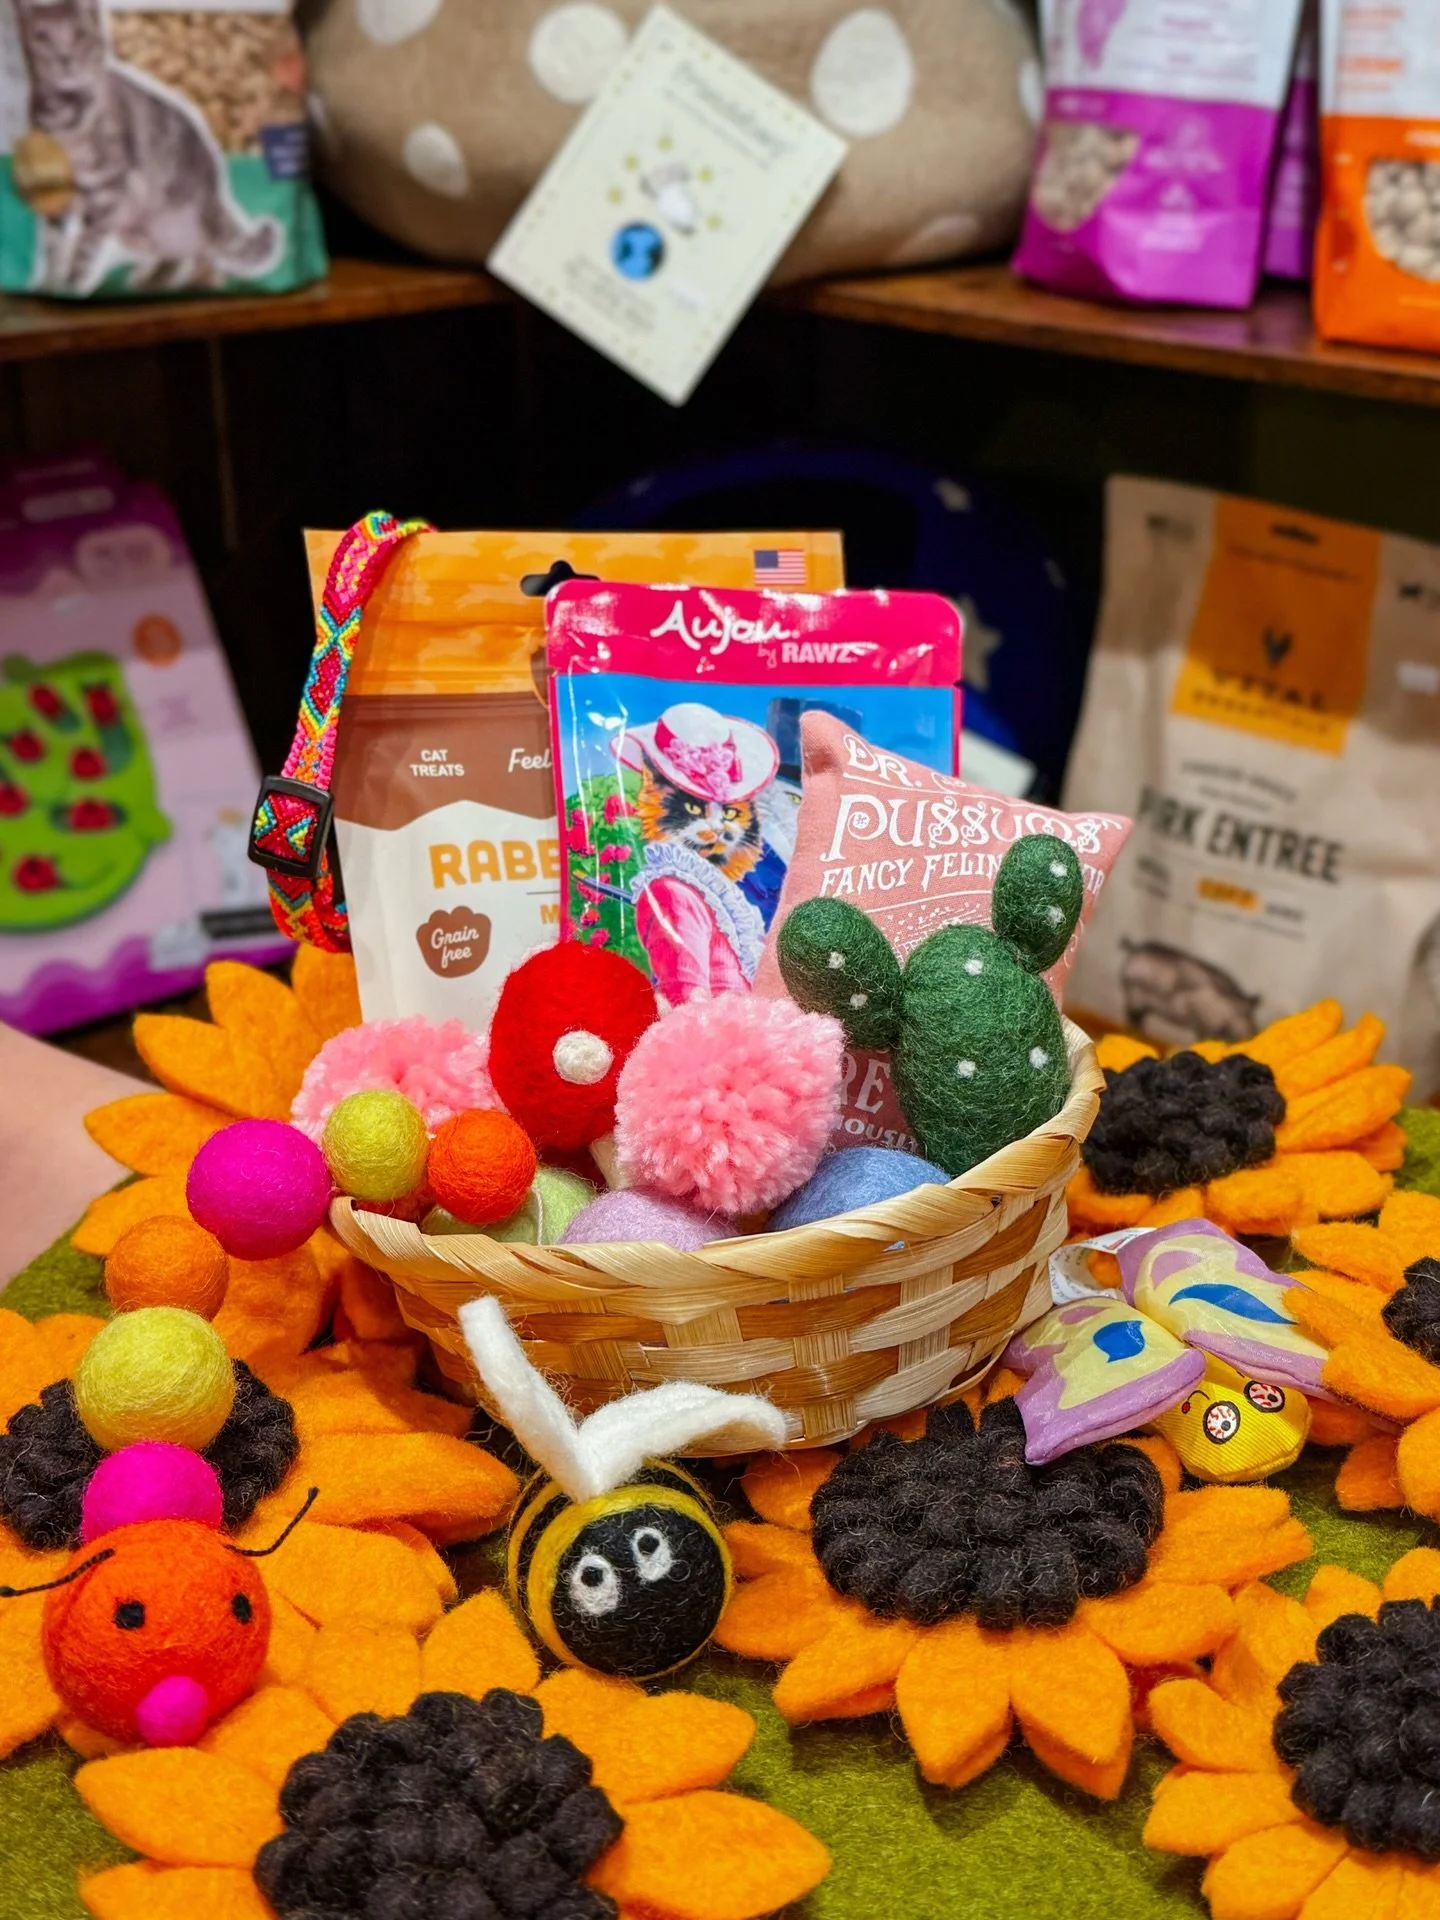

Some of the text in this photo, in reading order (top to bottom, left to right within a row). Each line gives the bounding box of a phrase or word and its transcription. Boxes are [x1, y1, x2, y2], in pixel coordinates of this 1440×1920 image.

[757, 641, 777, 669] by
[420, 749, 449, 762] CAT
[409, 764, 465, 777] TREATS
[1205, 811, 1345, 886] ENTREE
[820, 852, 1003, 899] FANCY FELIN
[431, 925, 480, 949] Grain
[440, 946, 472, 969] free
